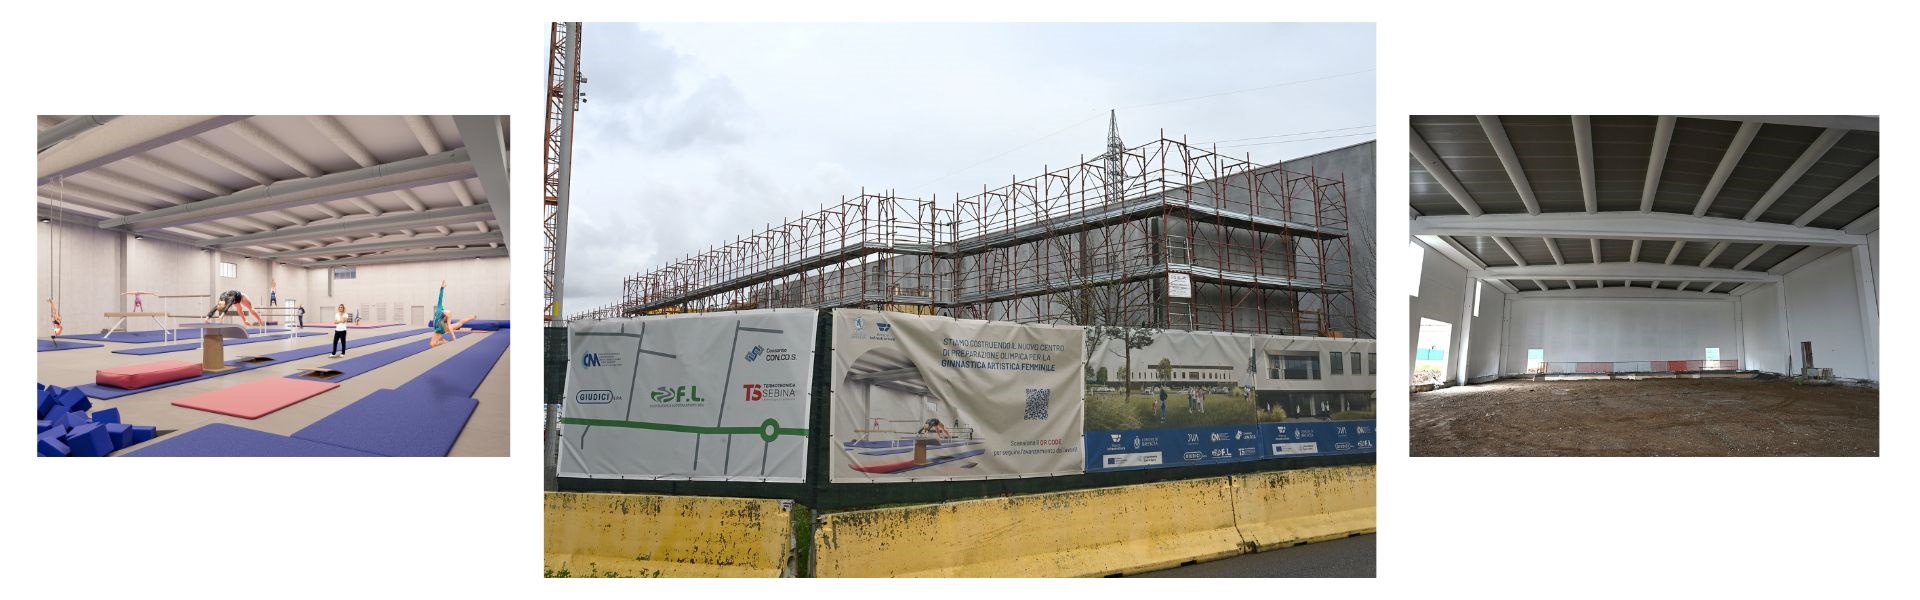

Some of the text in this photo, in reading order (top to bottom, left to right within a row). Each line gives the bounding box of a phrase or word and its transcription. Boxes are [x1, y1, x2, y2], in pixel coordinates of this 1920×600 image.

[943, 337, 969, 347] STIAMO
[969, 340, 1011, 349] COSTRUENDO
[1017, 342, 1039, 351] NUOVO
[1040, 344, 1064, 352] CENTRO
[943, 348, 950, 357] DI
[951, 350, 999, 359] PREPARAZIONE
[1000, 352, 1029, 360] OLIMPICA
[941, 359, 1056, 372] GINNASTICA ARTISTICA FEMMINILE
[580, 393, 610, 401] GIUDICI
[743, 384, 762, 401] TS
[762, 389, 796, 398] SEBINA
